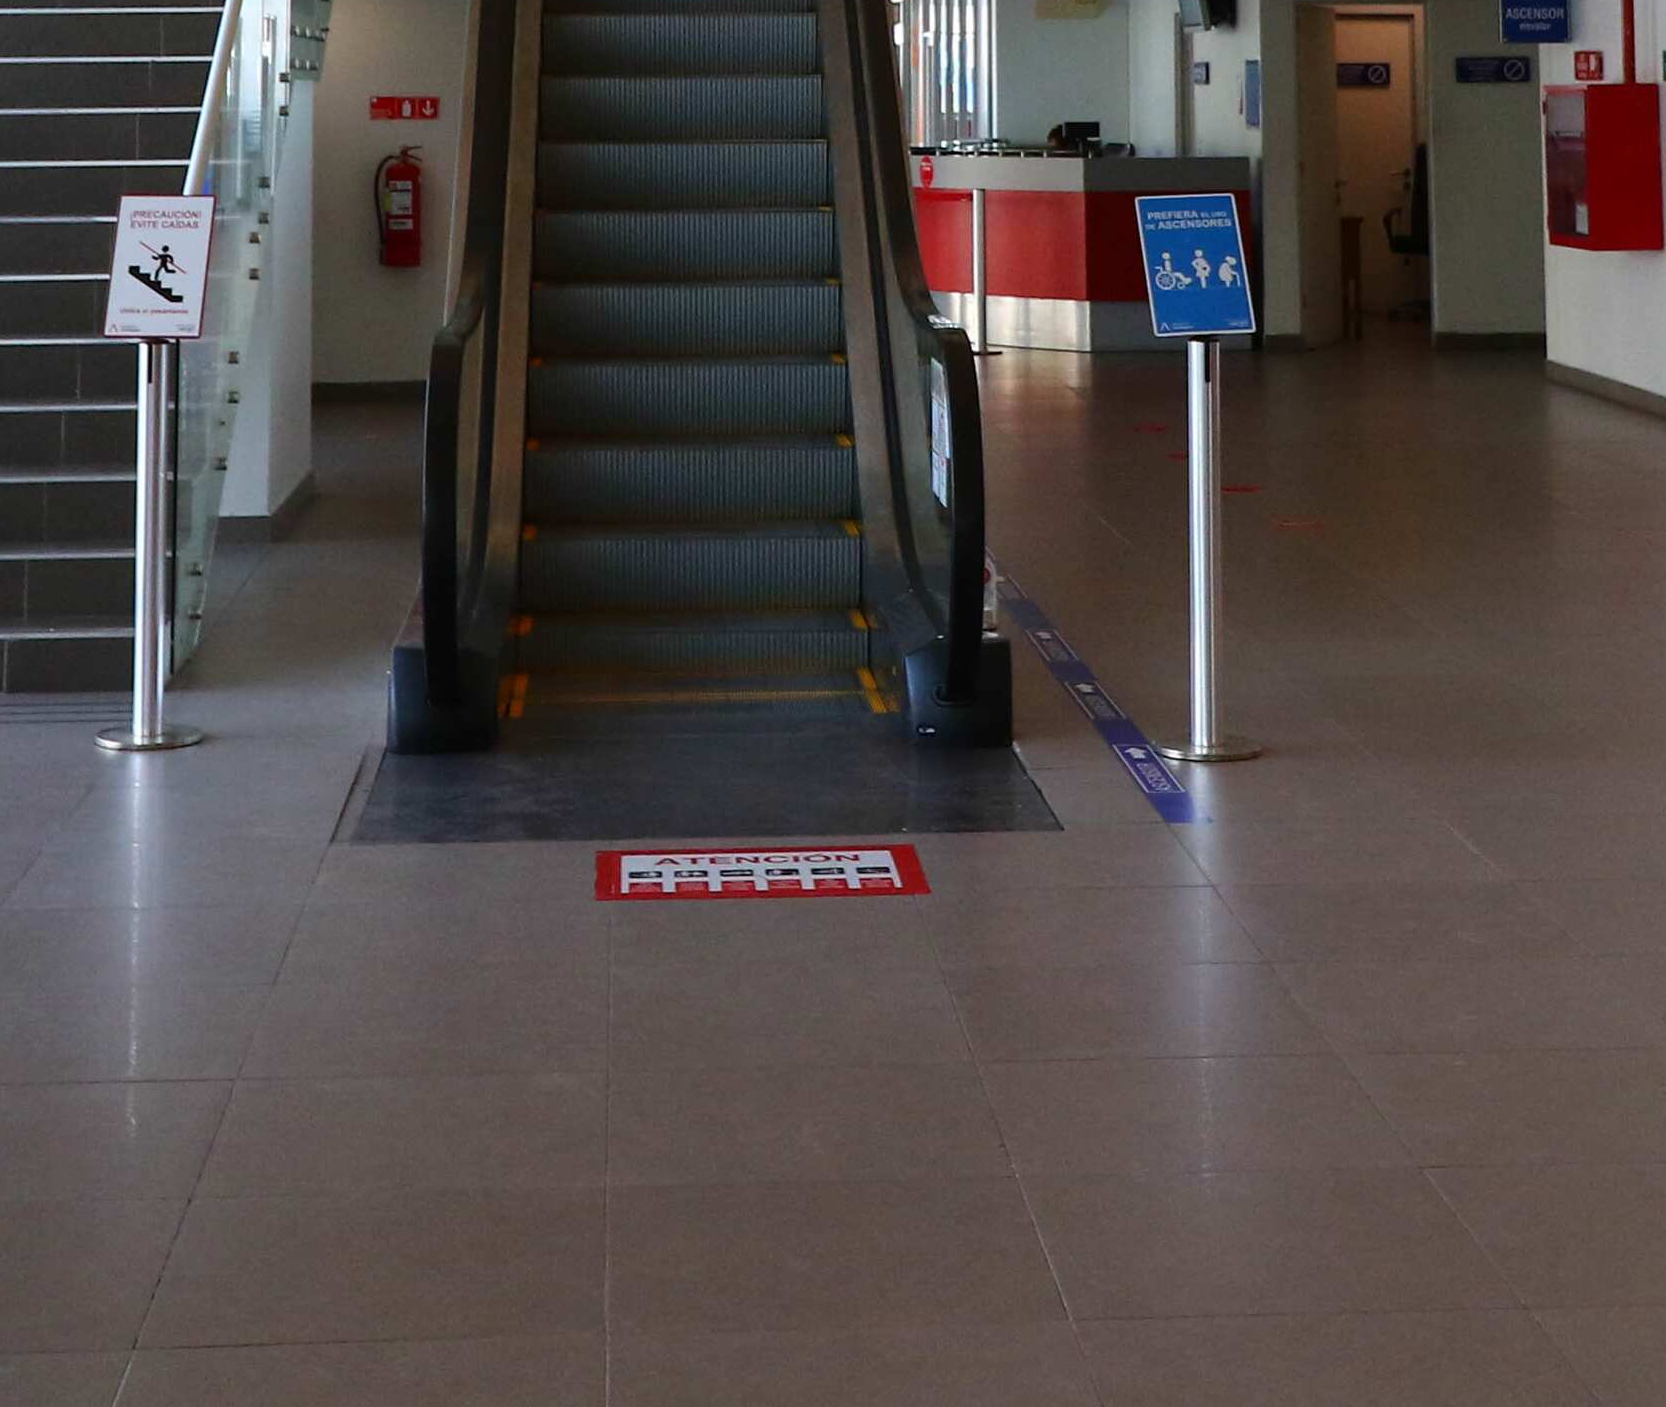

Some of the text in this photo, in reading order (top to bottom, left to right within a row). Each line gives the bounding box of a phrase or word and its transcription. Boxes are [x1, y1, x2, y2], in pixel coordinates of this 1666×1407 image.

[1505, 8, 1564, 19] ASCENSOR
[1147, 210, 1199, 220] PREFIERA
[130, 220, 159, 229] EVITE
[1157, 218, 1232, 230] ASCENSORES
[654, 853, 862, 866] ATENCIÓN
